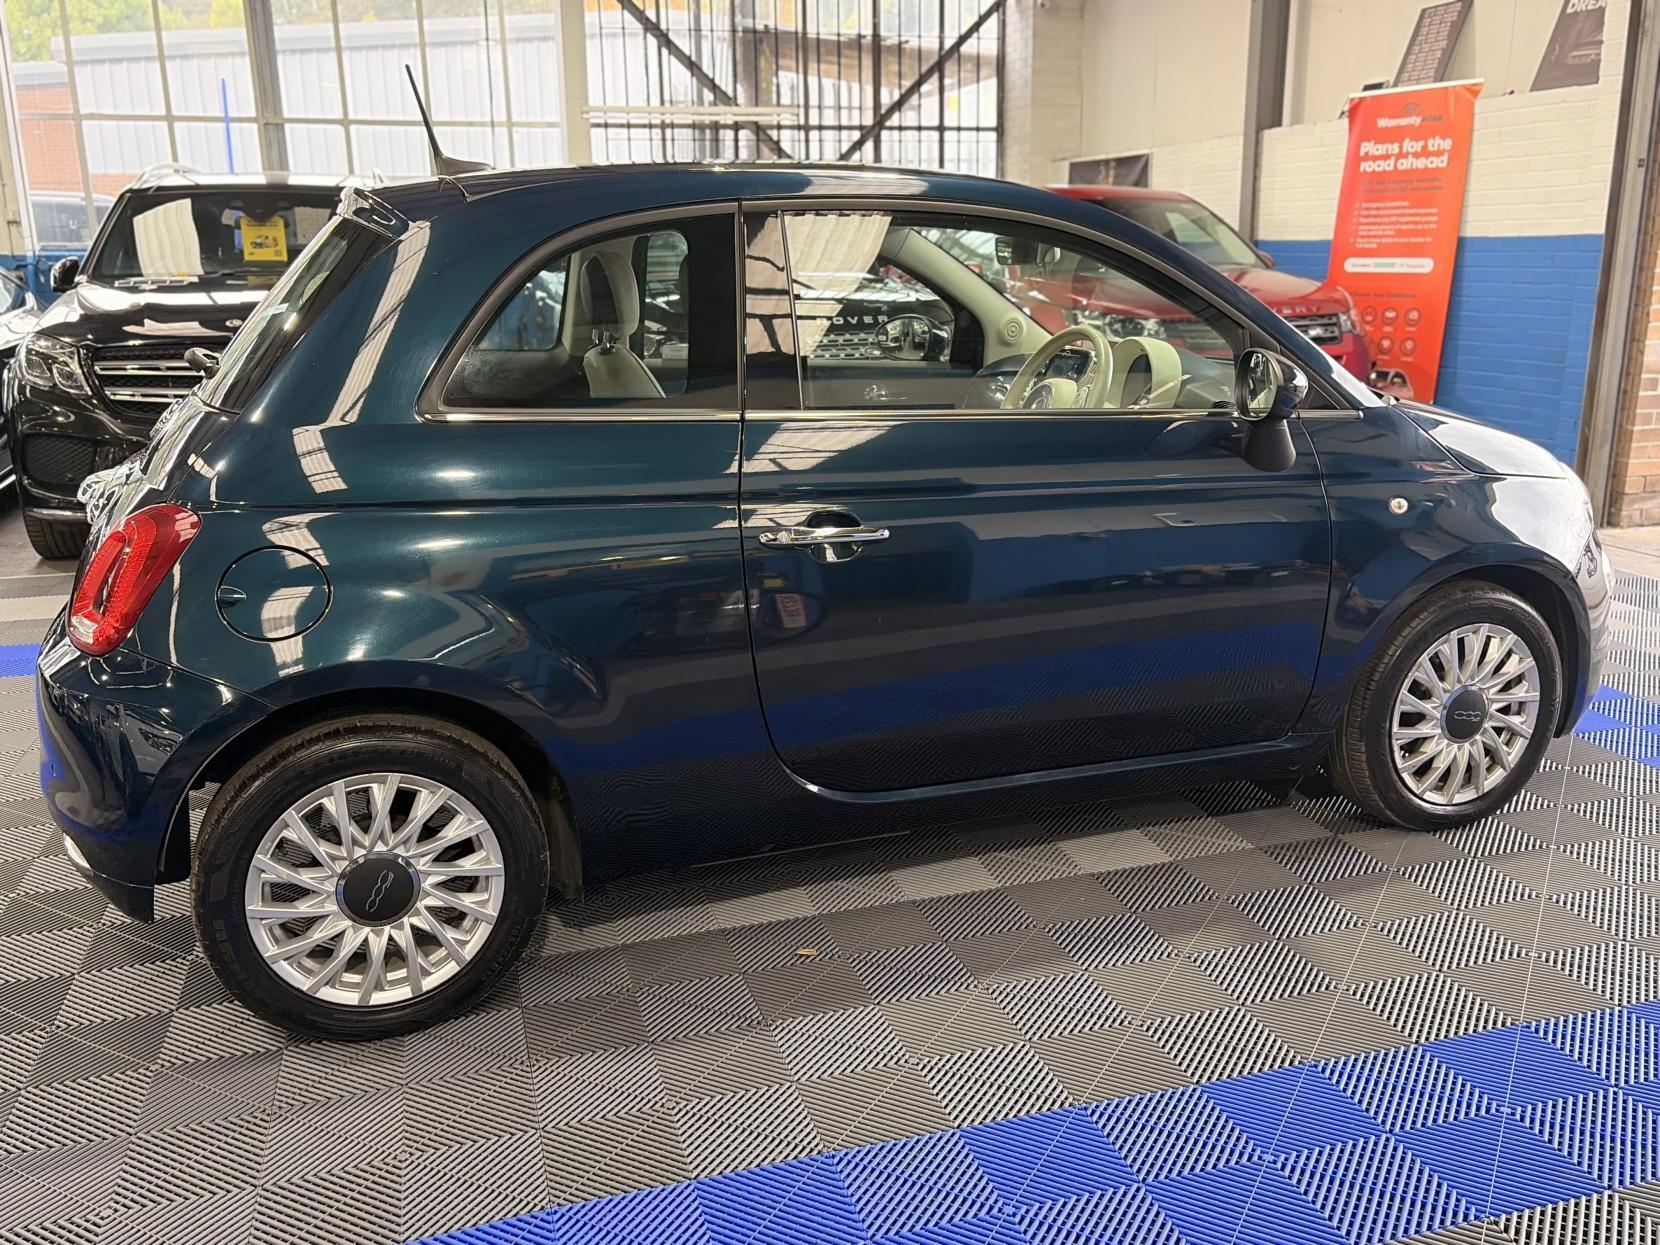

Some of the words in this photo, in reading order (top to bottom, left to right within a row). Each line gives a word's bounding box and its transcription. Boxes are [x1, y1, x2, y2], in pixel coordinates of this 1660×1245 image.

[1360, 140, 1400, 157] Plans
[1402, 137, 1425, 154] for
[1427, 135, 1453, 151] the
[1360, 156, 1396, 173] road
[1397, 152, 1449, 170] ahead
[816, 315, 888, 325] ROVER
